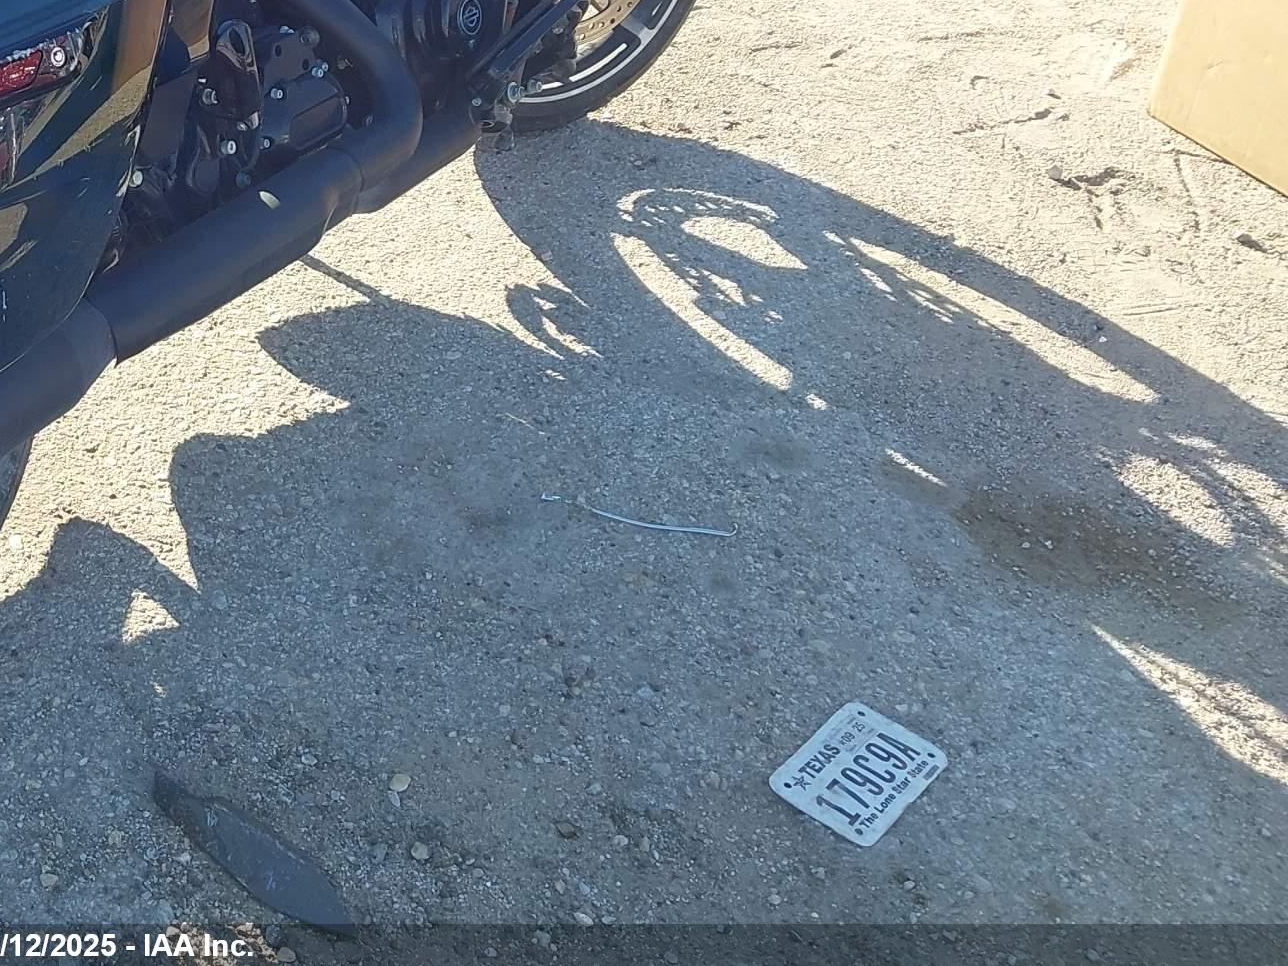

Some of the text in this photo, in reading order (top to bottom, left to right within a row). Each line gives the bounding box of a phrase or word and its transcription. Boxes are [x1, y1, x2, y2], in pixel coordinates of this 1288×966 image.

[798, 744, 840, 778] TEXAS
[816, 732, 921, 826] 179C9A
[858, 759, 929, 829] The Lone Star State
